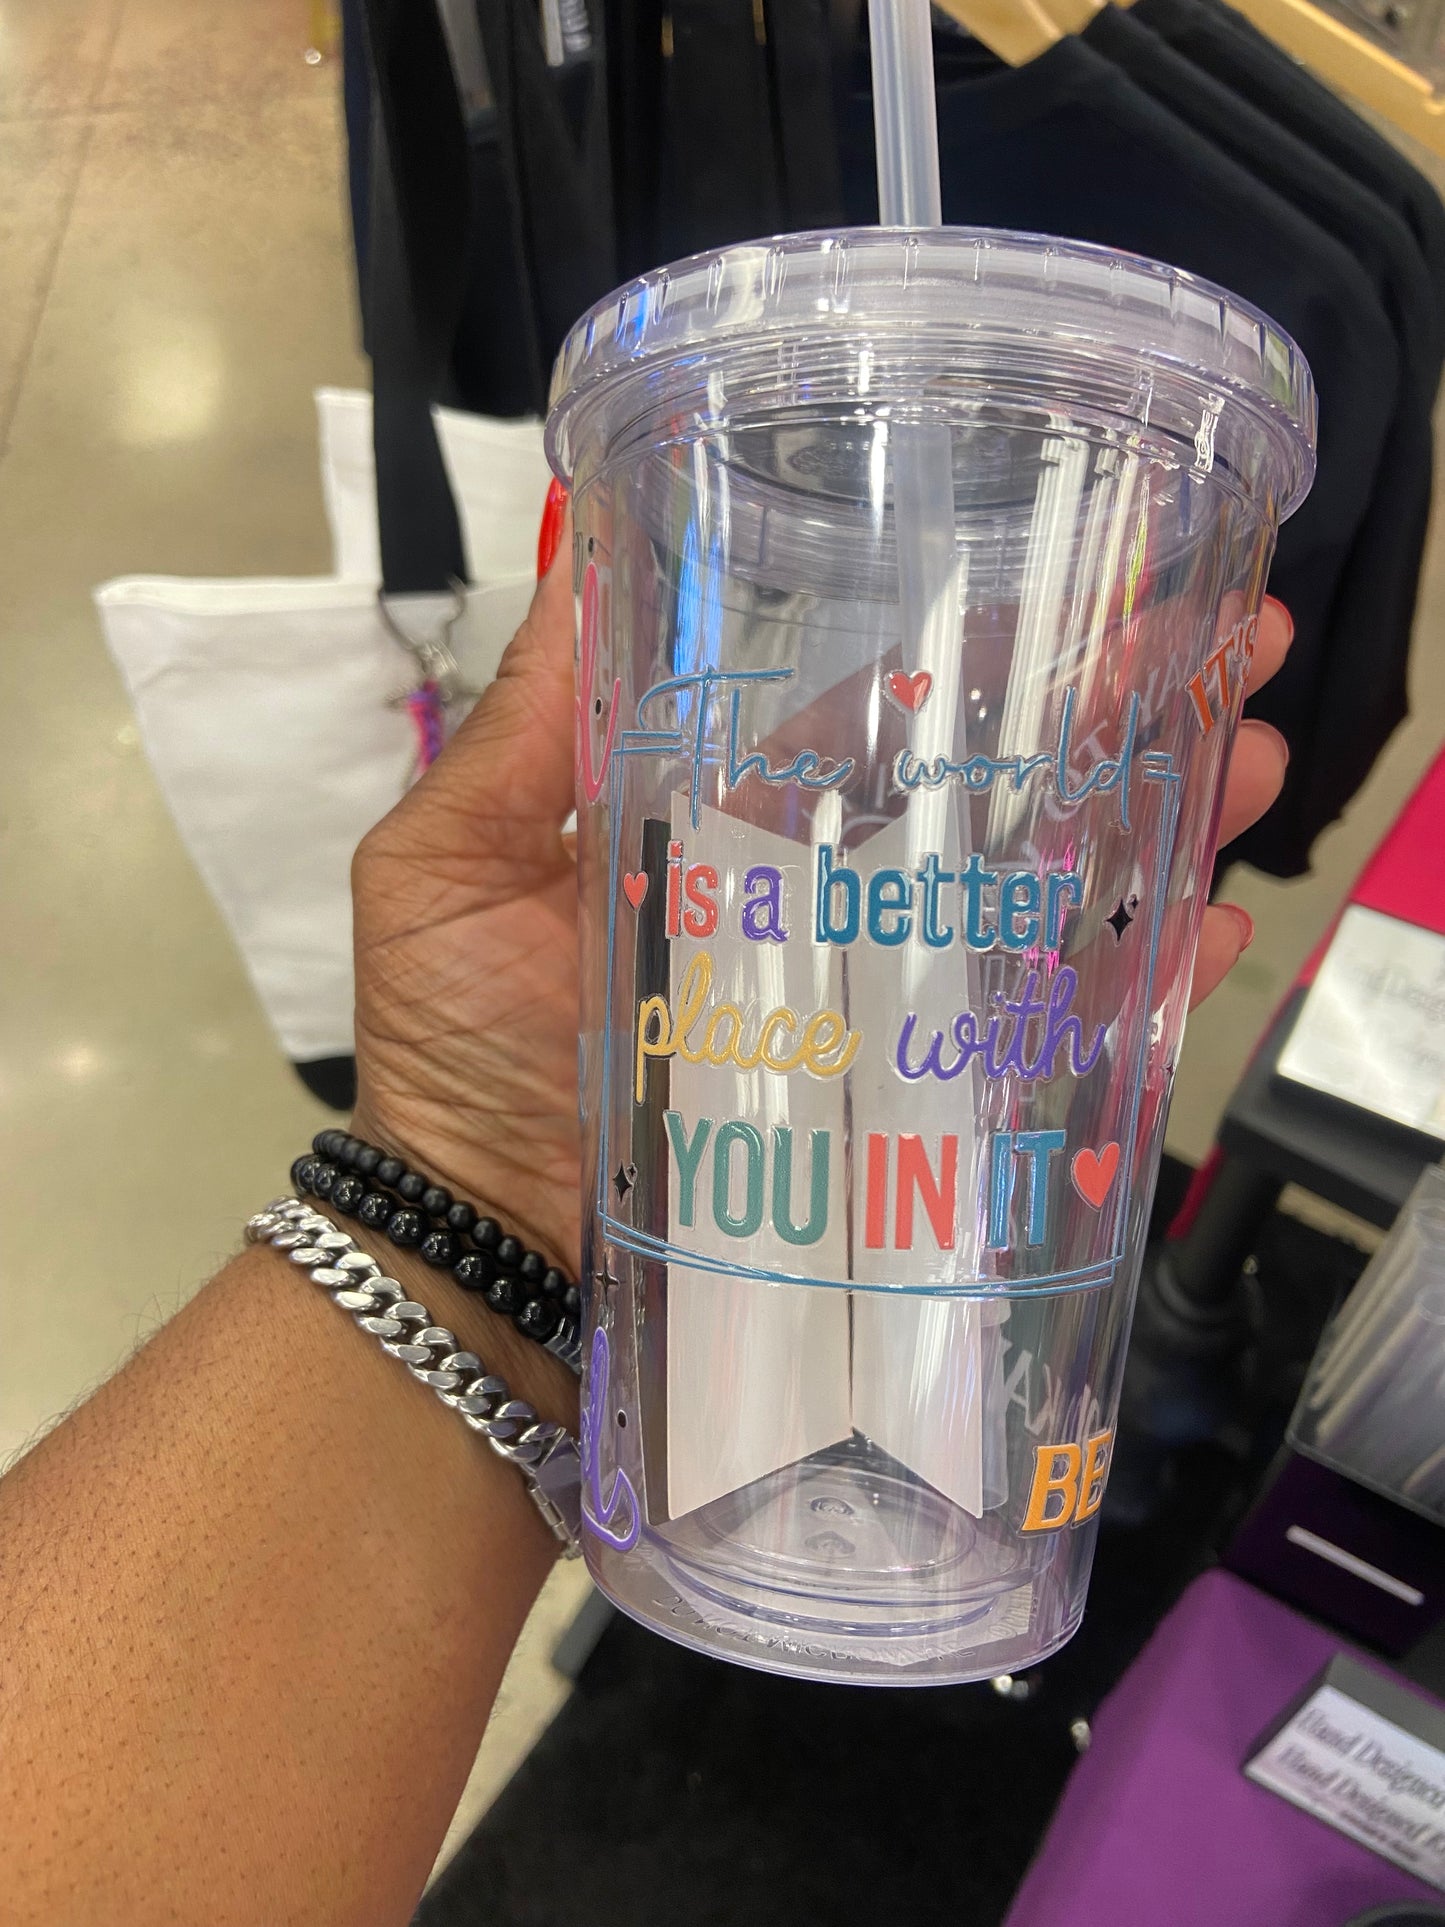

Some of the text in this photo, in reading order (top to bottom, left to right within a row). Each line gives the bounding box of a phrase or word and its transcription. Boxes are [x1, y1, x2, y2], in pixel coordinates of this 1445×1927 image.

[637, 665, 853, 830] The
[896, 684, 1140, 831] world
[665, 839, 1081, 950] is a better
[636, 952, 1105, 1103] place with
[663, 1111, 1065, 1250] YOU IN IT
